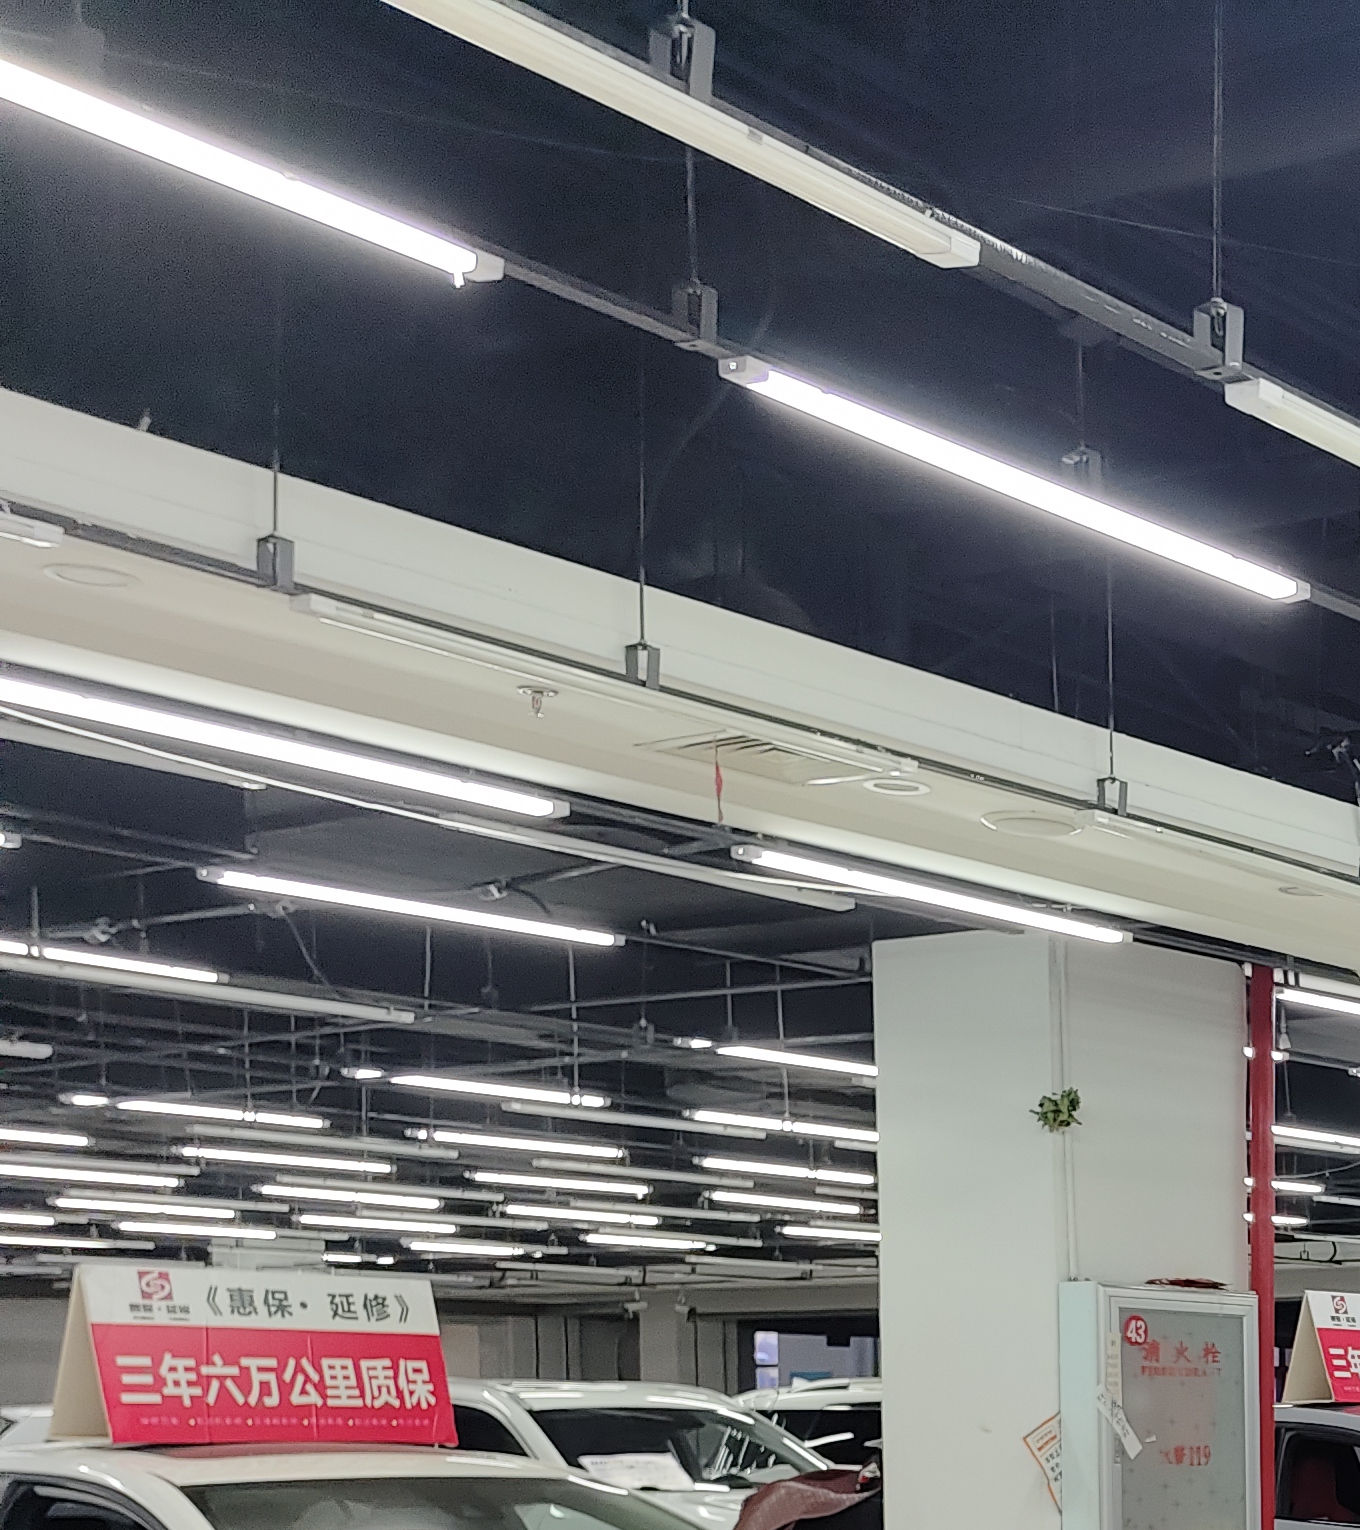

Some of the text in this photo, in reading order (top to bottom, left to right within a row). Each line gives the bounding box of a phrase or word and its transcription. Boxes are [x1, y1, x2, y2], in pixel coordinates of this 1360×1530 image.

[1126, 1319, 1146, 1343] 43
[115, 1352, 436, 1411] 三年六万公里质保
